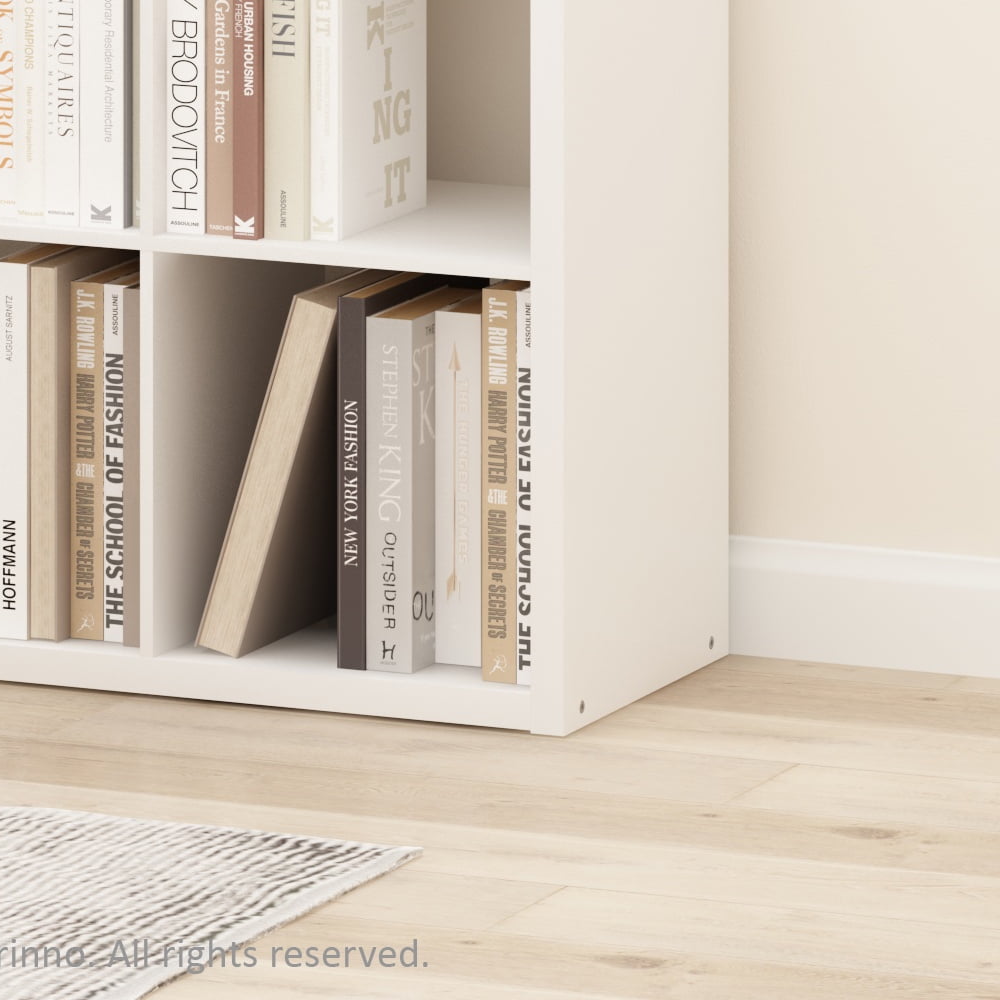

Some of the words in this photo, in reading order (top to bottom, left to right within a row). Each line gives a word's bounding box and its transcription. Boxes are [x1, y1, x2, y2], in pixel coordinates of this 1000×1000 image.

[24, 7, 34, 70] CHAMPIONS
[214, 0, 230, 65] Gardens
[234, 3, 243, 38] FRENCH
[243, 1, 254, 41] URBAN
[315, 16, 332, 38] IT
[103, 30, 115, 83] Residential
[215, 68, 229, 84] in
[243, 44, 255, 96] HOUSING
[103, 85, 115, 143] Architecture
[171, 19, 199, 211] BRODOVITCH
[214, 89, 230, 144] France
[384, 156, 411, 208] IT
[5, 295, 13, 328] SARNITZ
[76, 289, 95, 312] J.K.
[111, 294, 119, 336] ASSOULINE
[487, 297, 508, 323] J.K.
[5, 329, 13, 362] AUGUST
[76, 316, 95, 369] ROWLING
[488, 327, 508, 385] ROWLING
[76, 373, 95, 412] HARRY
[105, 353, 123, 450] FASHION
[381, 344, 399, 439] STEPHEN
[458, 380, 470, 414] THE
[488, 390, 508, 433] HARRY
[76, 415, 95, 459] POTTER
[344, 399, 358, 472] FASHION
[458, 420, 470, 493] HUNGER
[488, 436, 508, 484] POTTER
[105, 454, 123, 484] OF
[378, 444, 402, 522] KING
[76, 482, 95, 538] CHAMBER
[344, 476, 358, 523] YORK
[105, 491, 123, 580] SCHOOL
[344, 527, 358, 567] NEW
[457, 500, 469, 564] GAMES
[488, 510, 508, 570] CHAMBER
[2, 519, 16, 611] HOFFMANN
[76, 551, 95, 600] SECRETS
[382, 532, 398, 629] OUTSIDER
[105, 585, 123, 629] THE
[488, 584, 507, 639] SECRETS
